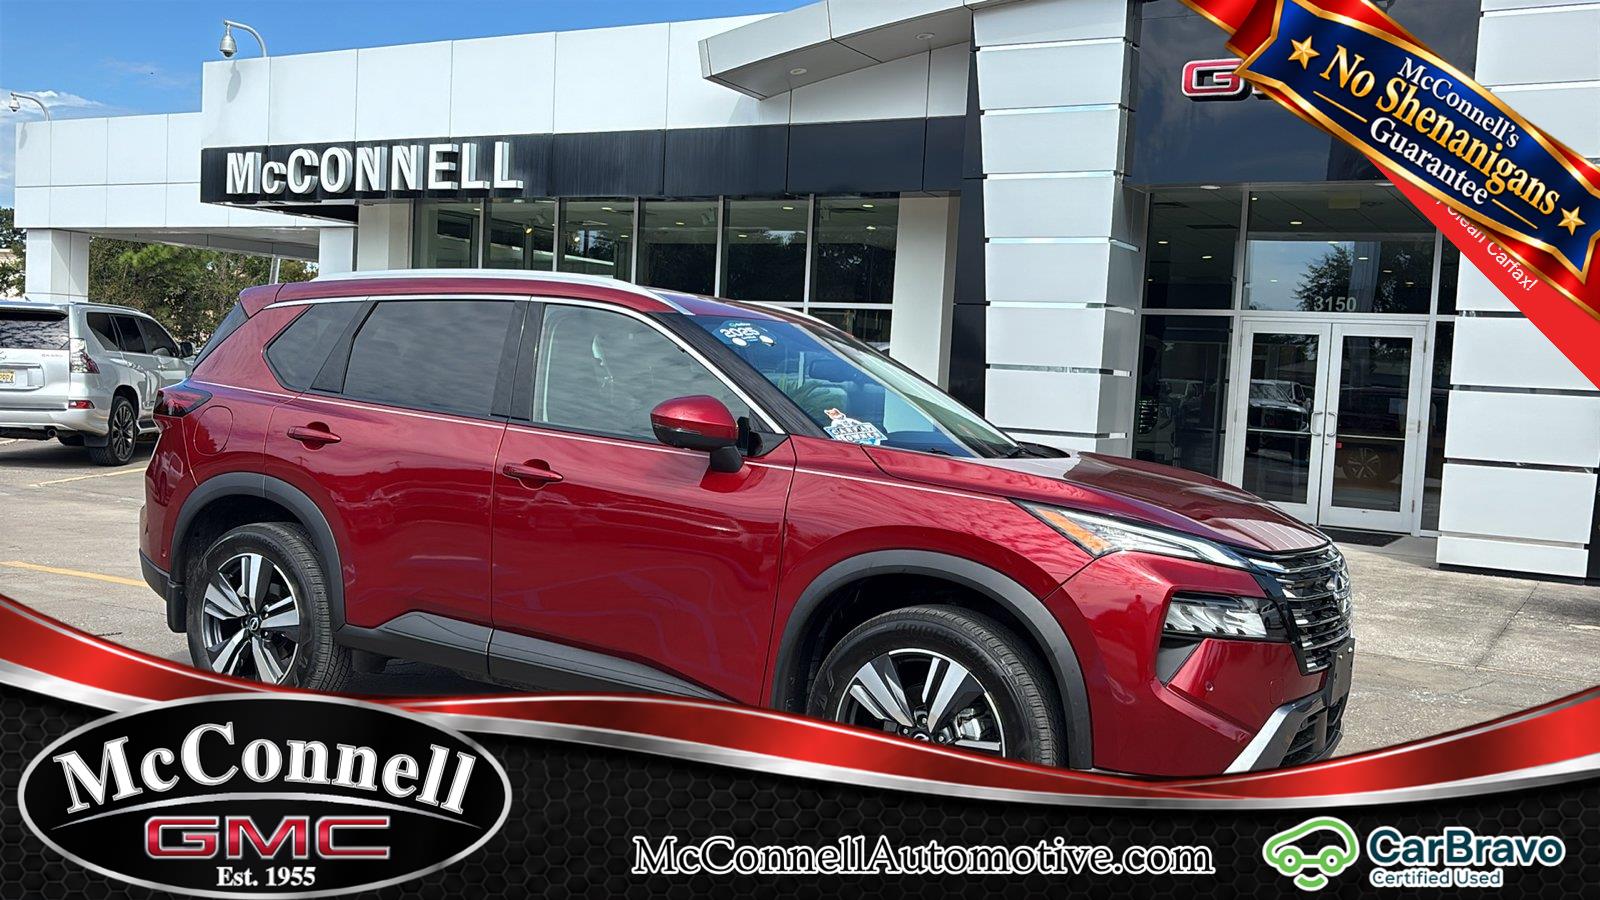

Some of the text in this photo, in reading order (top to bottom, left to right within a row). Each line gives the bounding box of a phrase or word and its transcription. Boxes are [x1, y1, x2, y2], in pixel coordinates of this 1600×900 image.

[226, 141, 524, 194] McCONNELL
[1313, 296, 1357, 312] 3150
[720, 326, 760, 338] 2025
